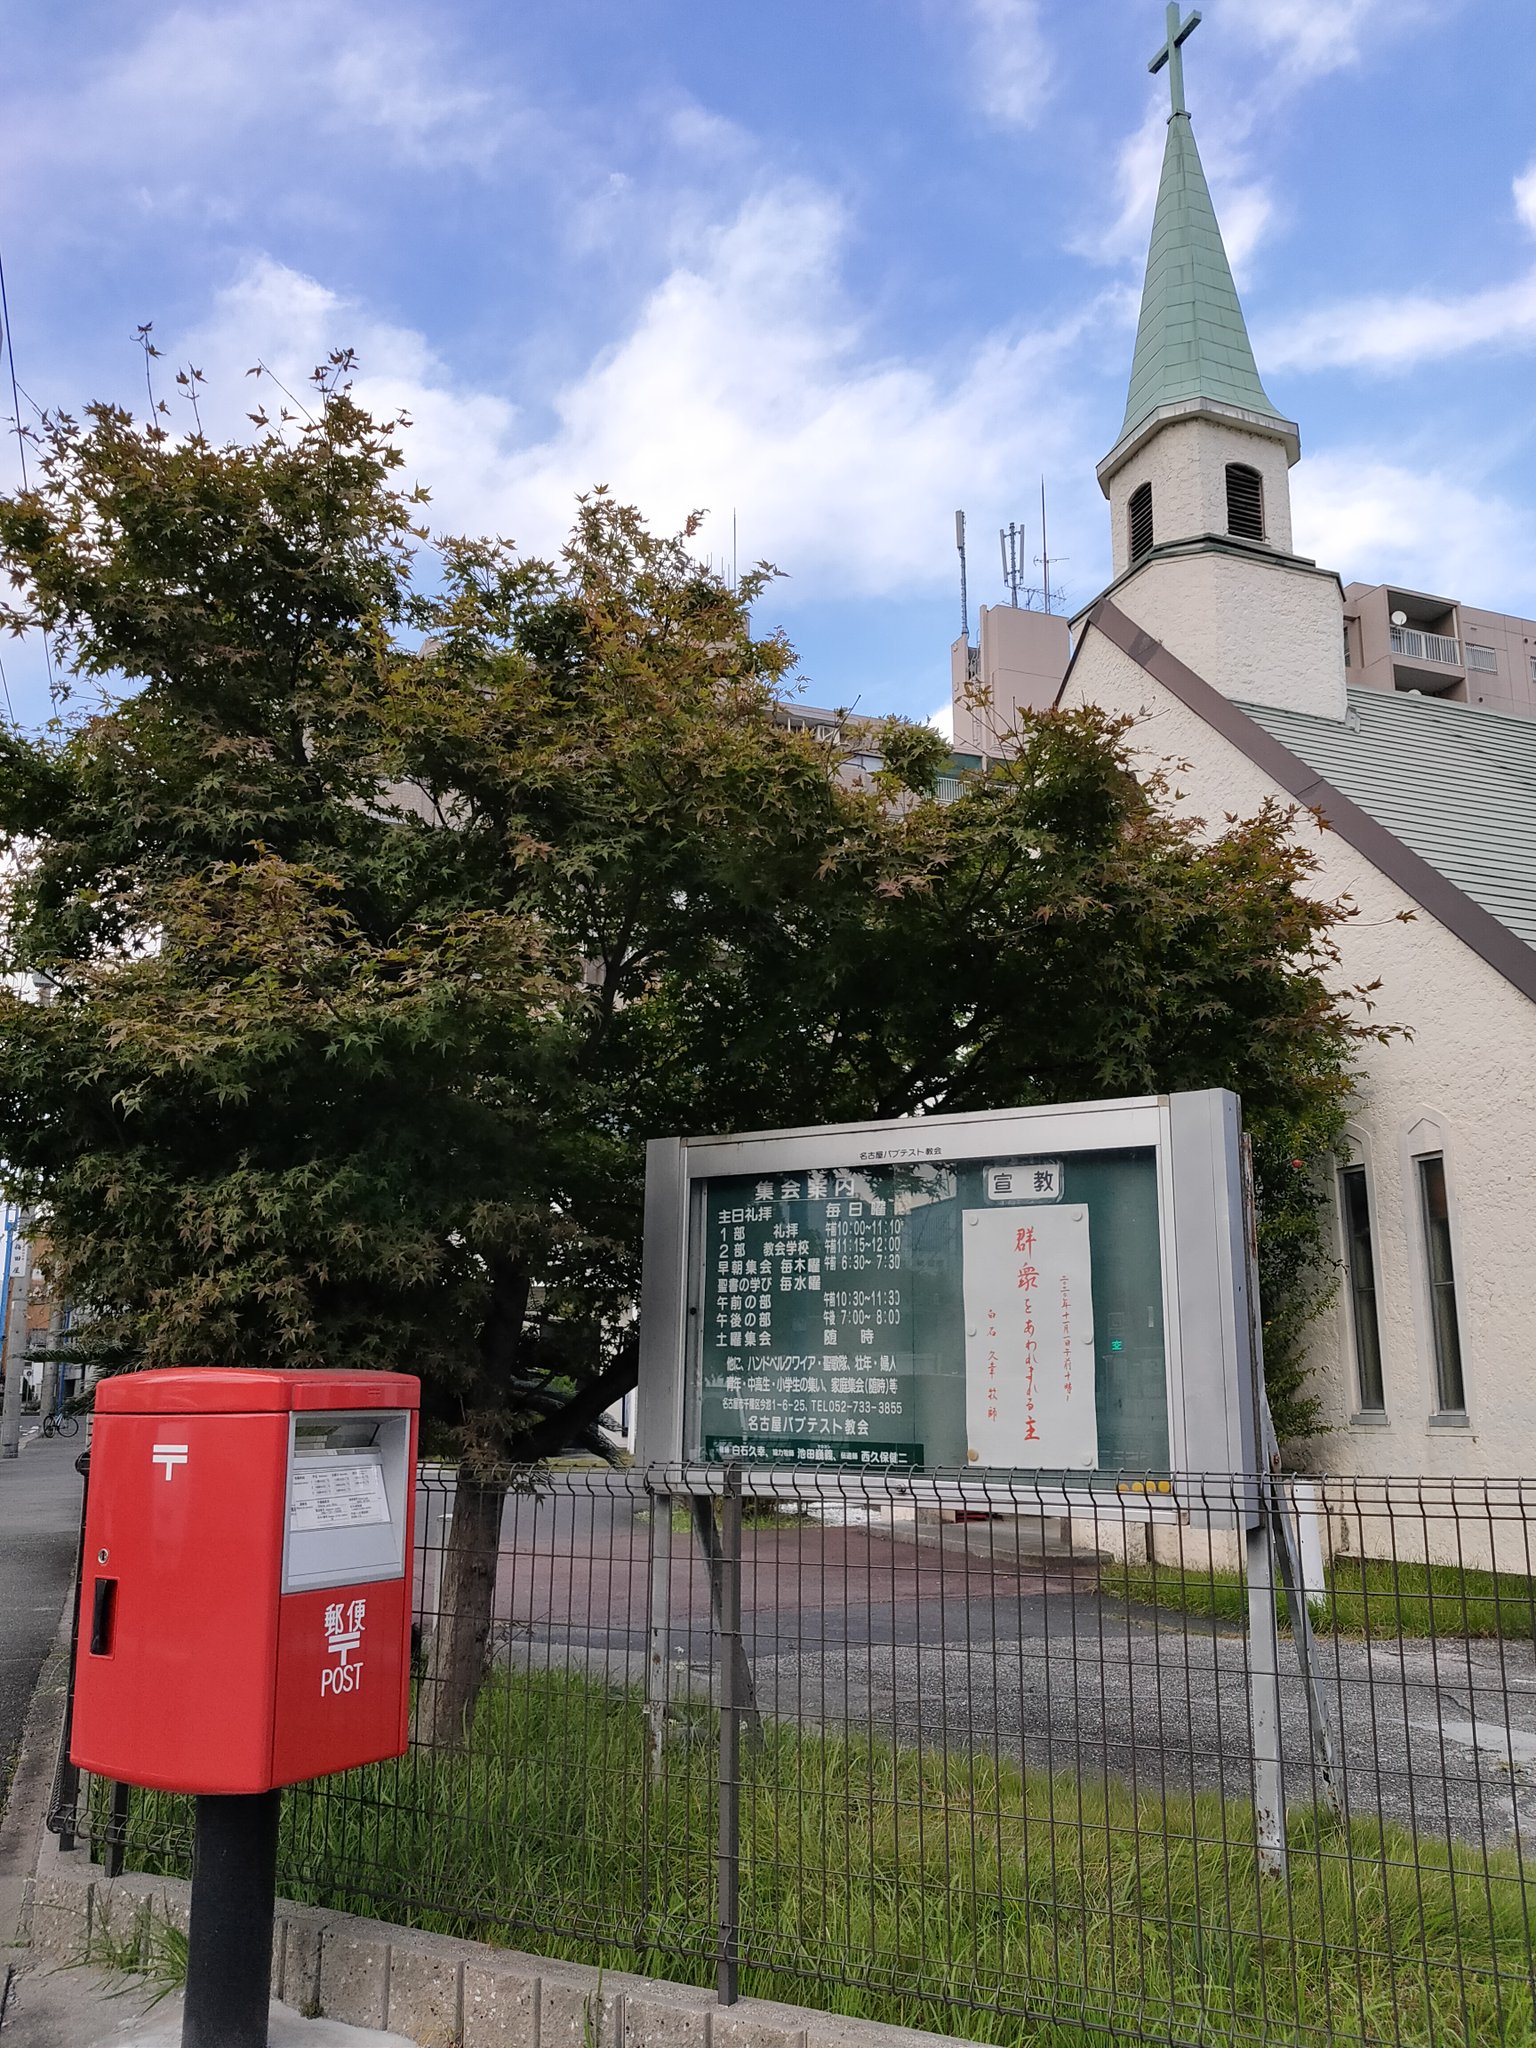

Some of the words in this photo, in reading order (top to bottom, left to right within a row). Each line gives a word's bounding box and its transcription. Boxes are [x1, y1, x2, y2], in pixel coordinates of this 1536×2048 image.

[755, 1175, 855, 1200] 集会案内
[993, 1170, 1054, 1193] 宣教
[718, 1206, 772, 1224] 主日礼拝
[773, 1222, 799, 1239] 礼拝
[763, 1240, 810, 1257] 教会学校
[718, 1259, 772, 1275] 早朝集会
[780, 1257, 820, 1274] 毎木曜
[717, 1277, 772, 1293] 聖書の学び
[780, 1275, 821, 1291] 毎水曜
[717, 1294, 772, 1311] 午前の部
[716, 1312, 772, 1328] 午後の部
[716, 1331, 772, 1347] 土曜集会
[748, 1415, 869, 1436] 名古屋バプテスト教会
[324, 1598, 367, 1637] 郵便
[321, 1662, 364, 1697] POST
